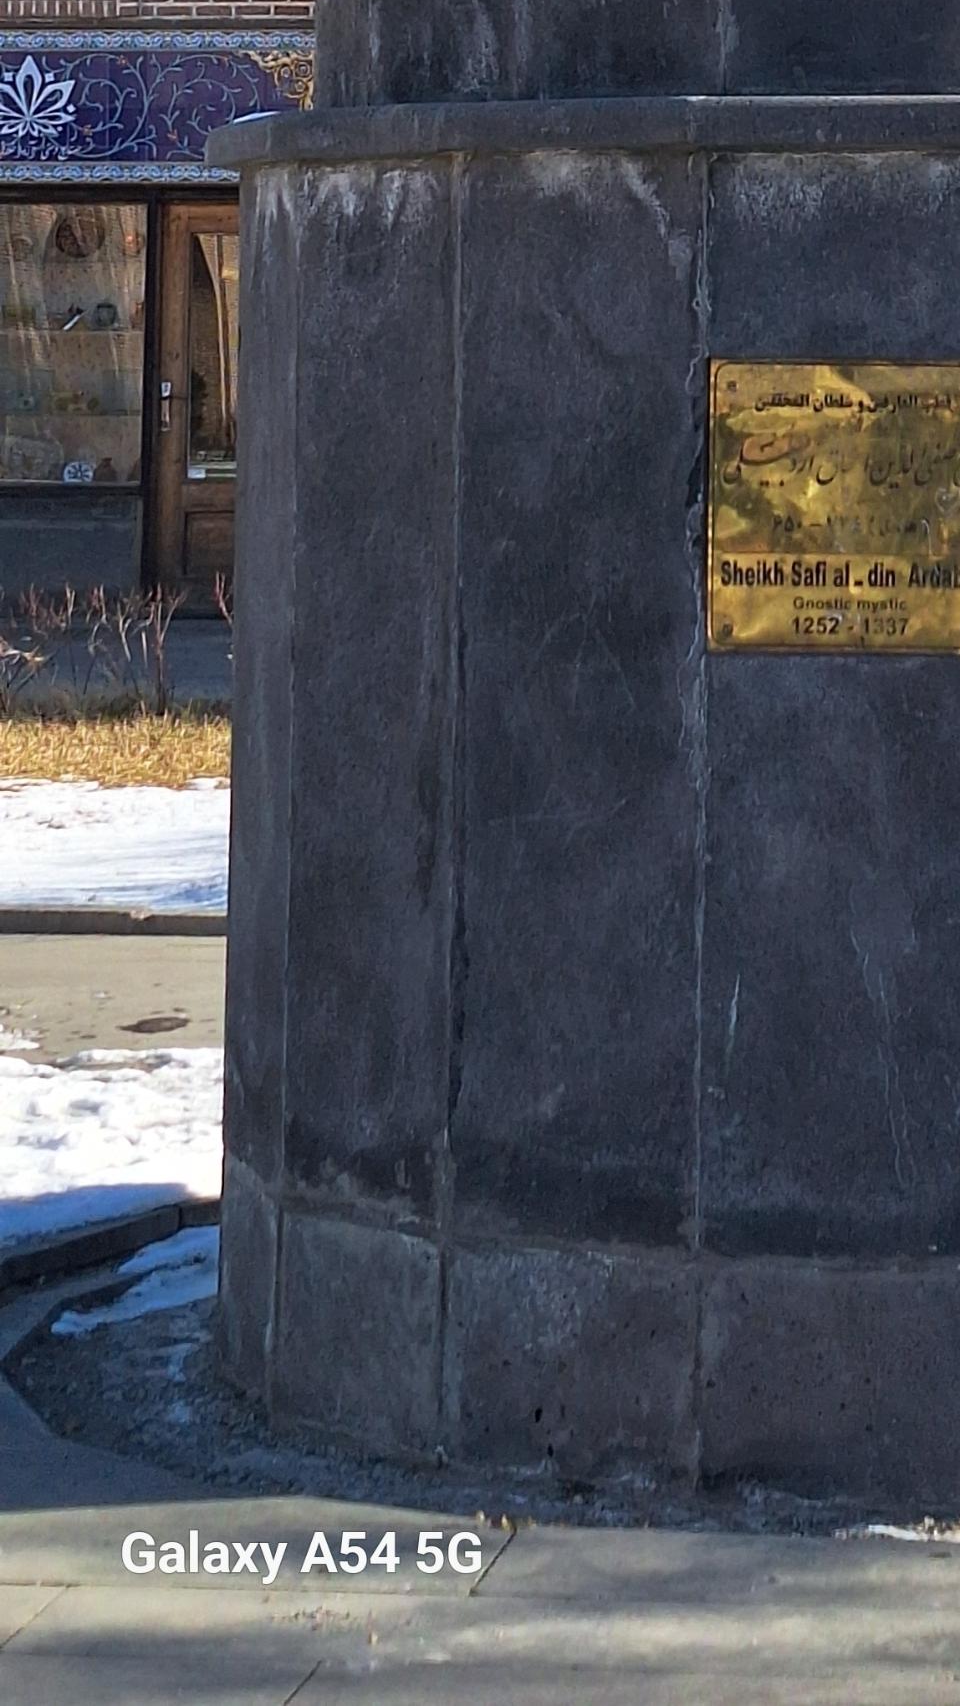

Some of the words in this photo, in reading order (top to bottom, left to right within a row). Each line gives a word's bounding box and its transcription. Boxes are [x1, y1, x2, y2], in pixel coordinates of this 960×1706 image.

[754, 392, 810, 412] المحققین
[813, 394, 853, 412] سلطان
[857, 398, 865, 412] و
[720, 560, 784, 587] Sheikh
[791, 561, 827, 587] Safi
[793, 595, 851, 609] Gnostic
[857, 597, 907, 612] mystic
[792, 616, 840, 635] 1252
[864, 617, 909, 636] 1337
